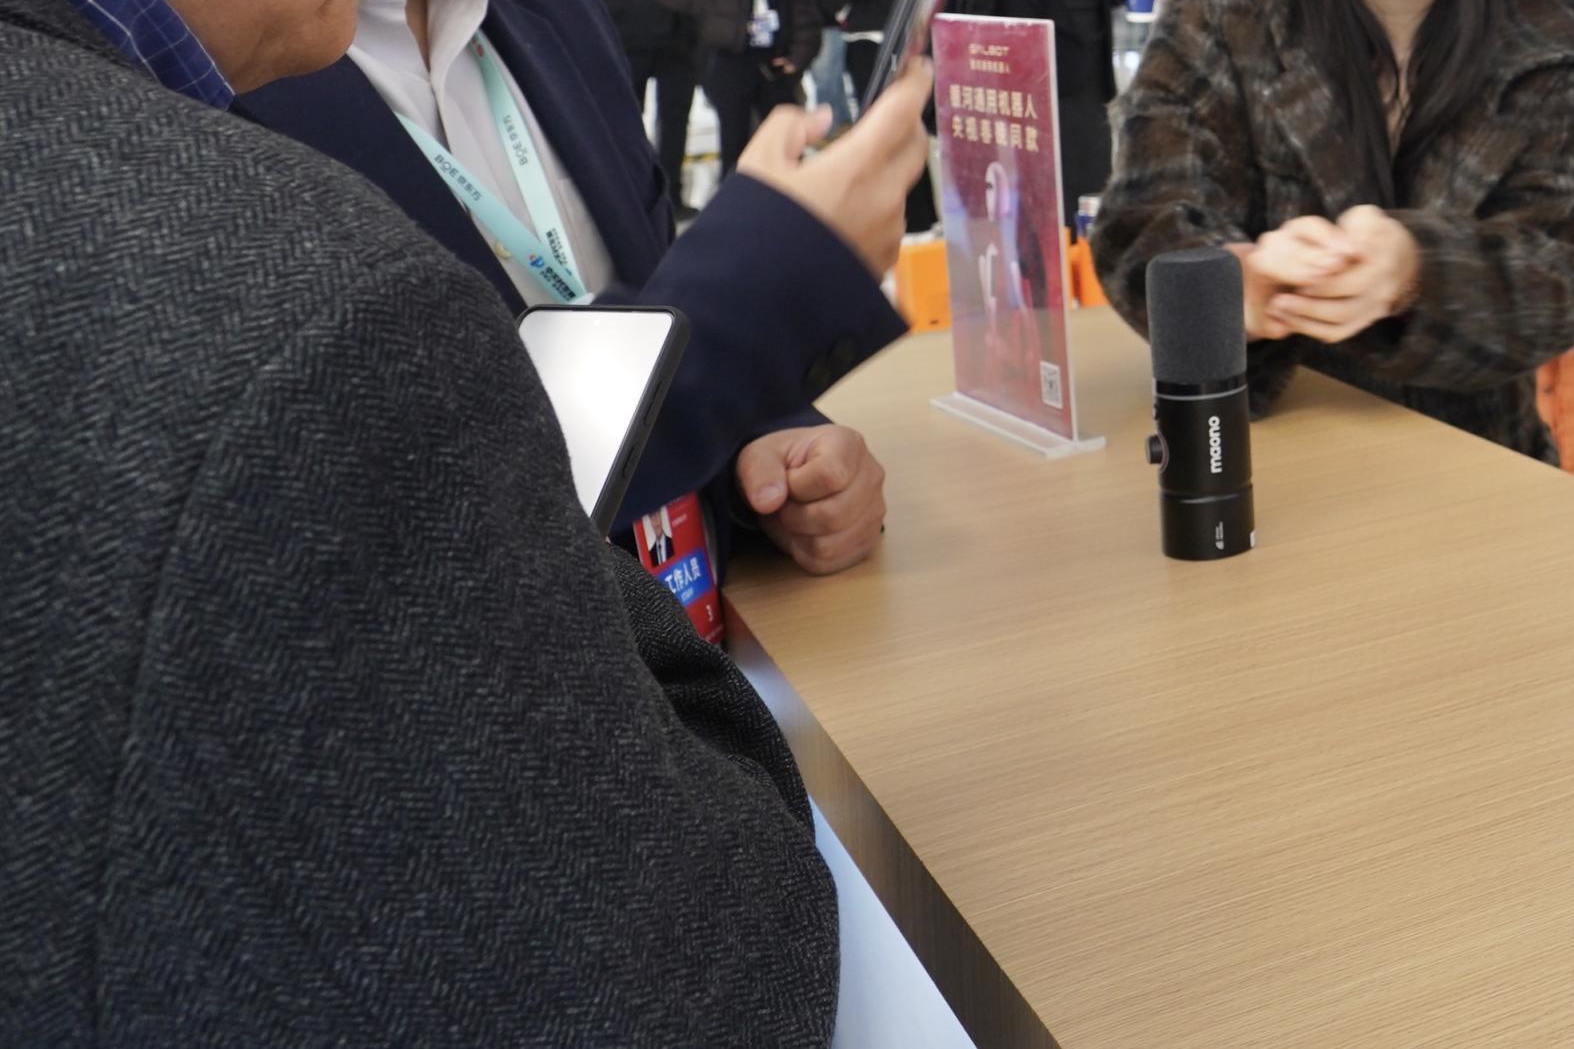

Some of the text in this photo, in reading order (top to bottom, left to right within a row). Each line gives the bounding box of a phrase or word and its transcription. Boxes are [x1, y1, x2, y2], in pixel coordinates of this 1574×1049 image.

[1208, 416, 1223, 474] maono
[664, 557, 702, 594] 工作人员
